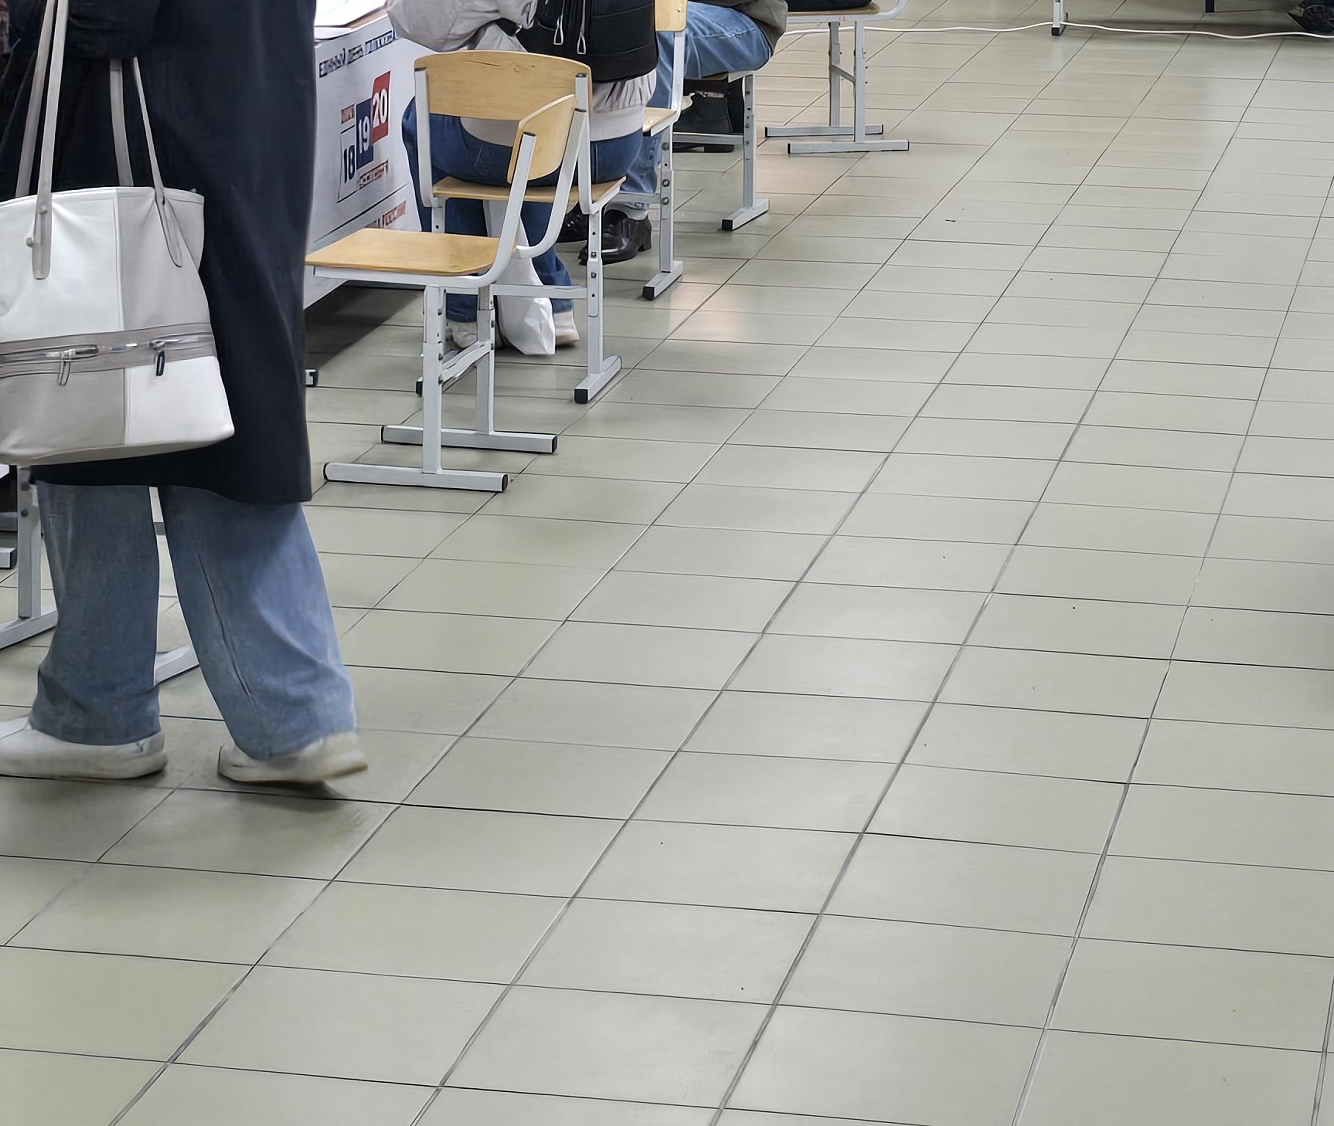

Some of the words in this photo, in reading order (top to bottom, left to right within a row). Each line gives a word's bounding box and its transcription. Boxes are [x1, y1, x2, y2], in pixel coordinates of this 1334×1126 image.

[344, 144, 356, 184] 18
[358, 115, 370, 154] 19
[372, 88, 388, 129] 20
